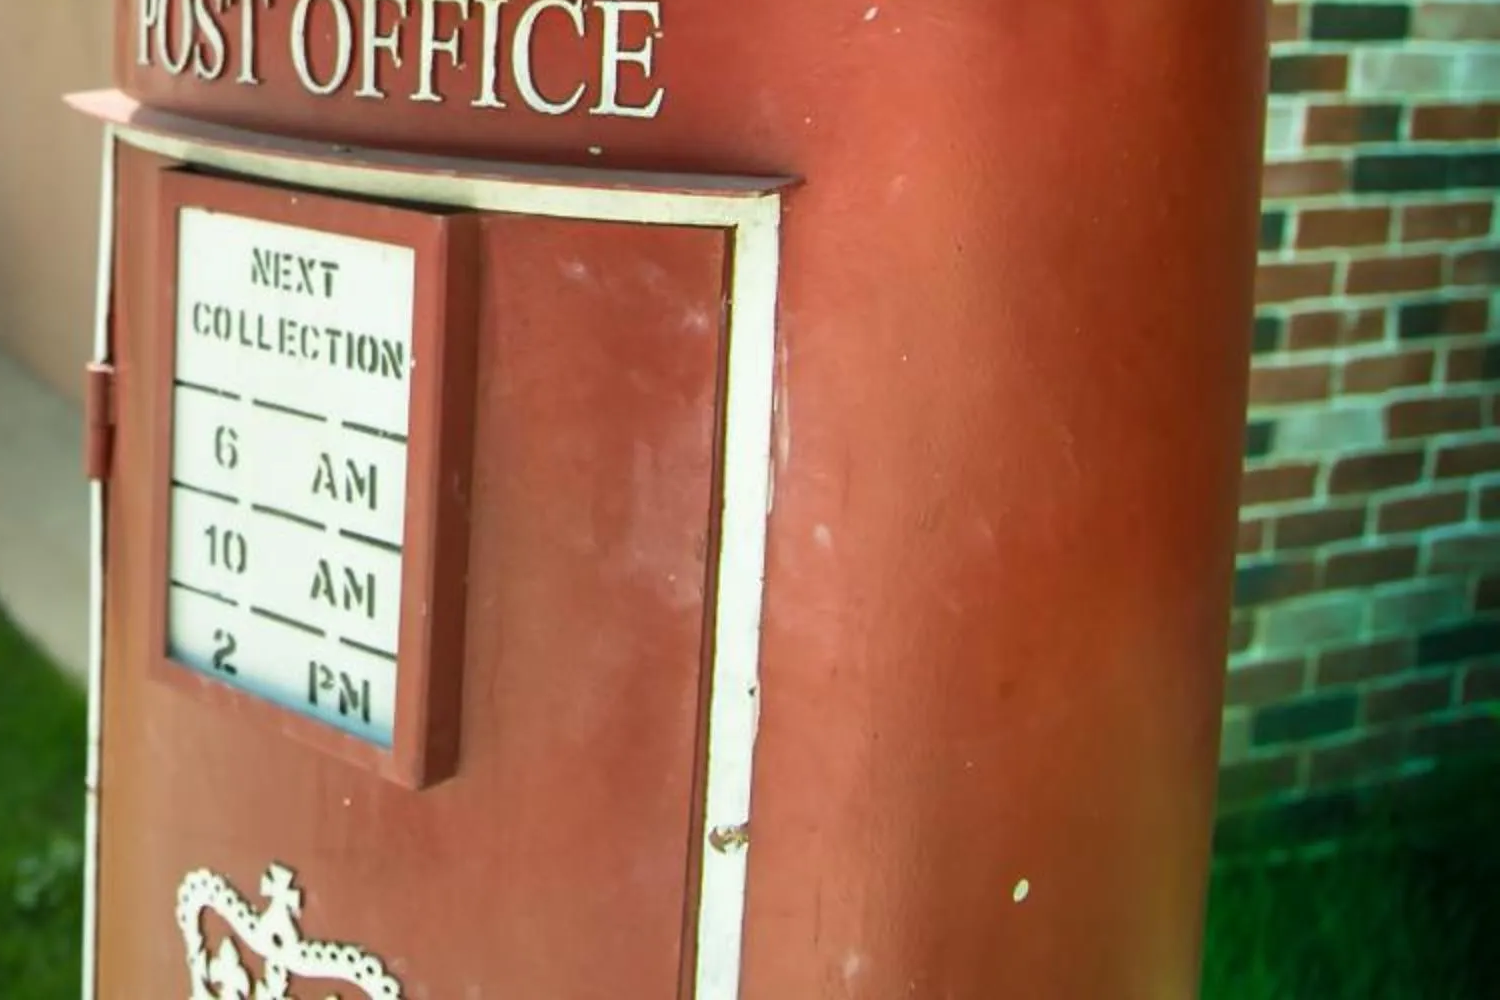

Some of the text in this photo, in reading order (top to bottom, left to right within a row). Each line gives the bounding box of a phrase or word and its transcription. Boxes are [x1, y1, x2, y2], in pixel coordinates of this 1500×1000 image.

[251, 247, 339, 298] NEXT
[193, 302, 404, 380] COLLECTION
[214, 425, 377, 510] 6 AM
[204, 525, 375, 619] 10 AM
[213, 629, 371, 725] 2 PM
